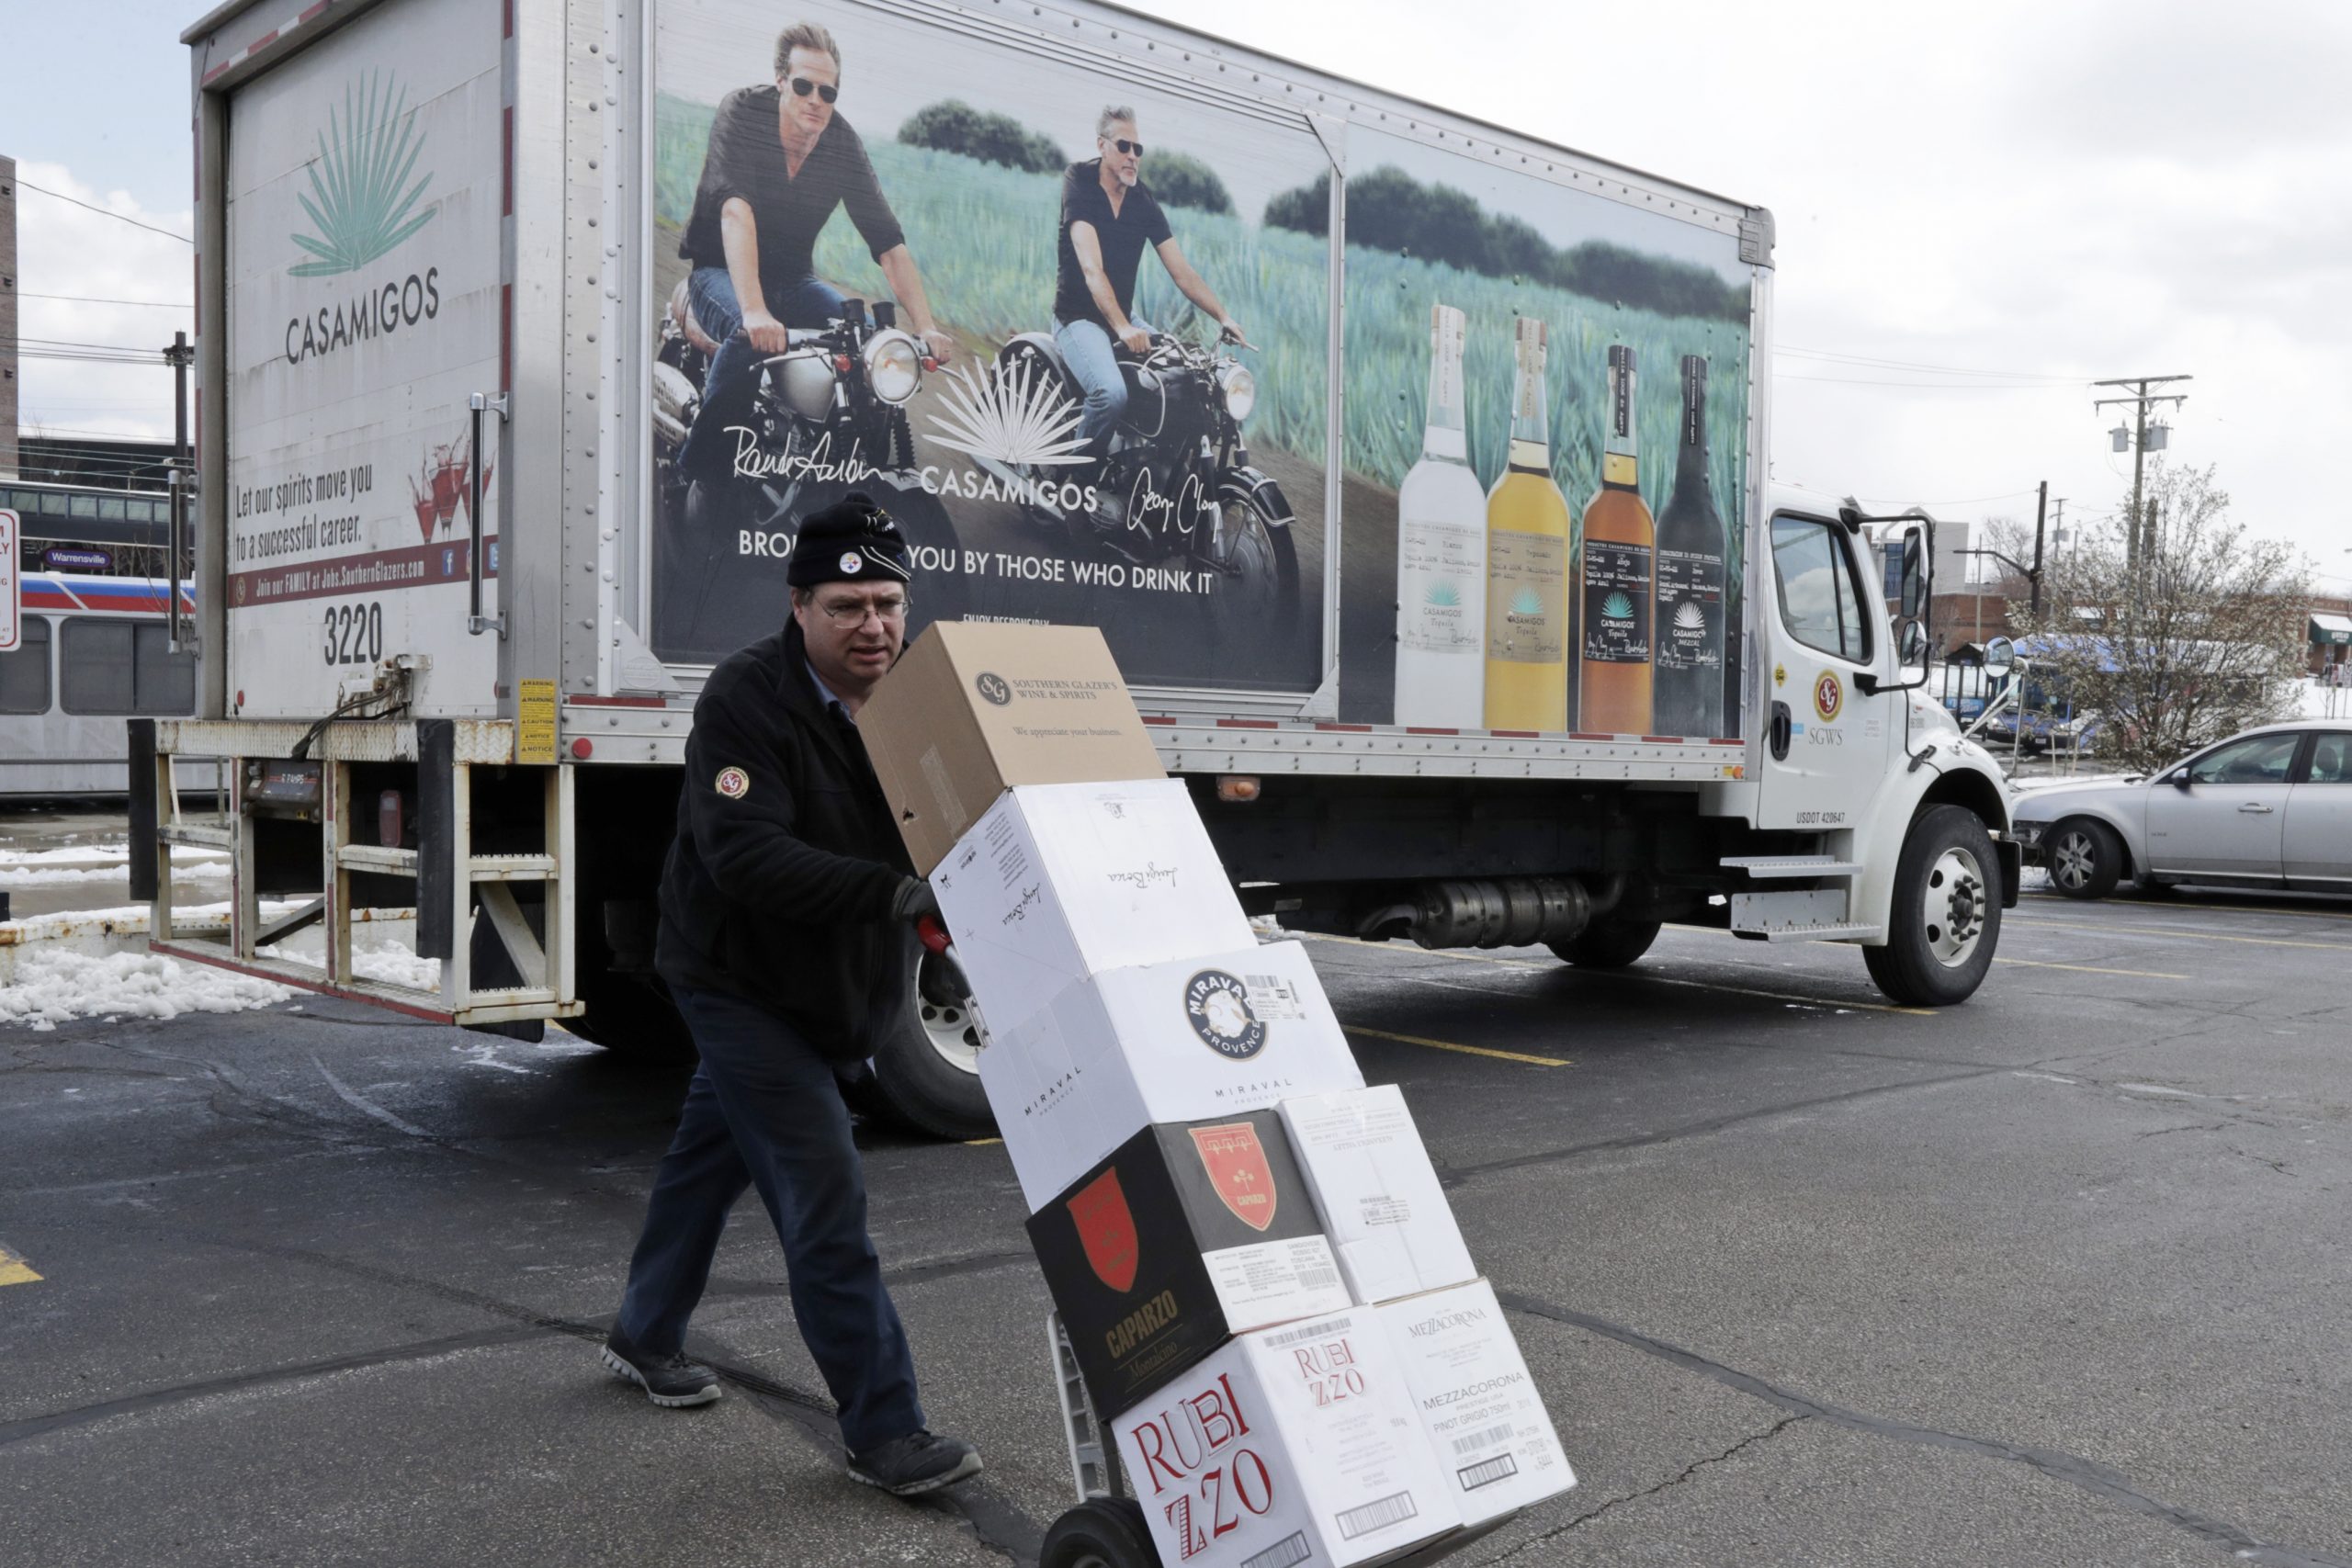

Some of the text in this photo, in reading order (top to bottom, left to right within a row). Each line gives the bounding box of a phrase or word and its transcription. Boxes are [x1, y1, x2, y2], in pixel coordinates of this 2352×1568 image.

[285, 266, 439, 365] CASAMIGOS
[236, 463, 372, 518] Let our spirits move you
[920, 466, 1097, 513] CASAMIGOS
[236, 513, 361, 561] to a successful career.
[51, 553, 106, 564] Warrensville
[906, 544, 956, 574] YOU
[964, 551, 989, 576] BY
[996, 554, 1065, 582] THOSE
[1071, 560, 1125, 588] WHO
[1132, 566, 1193, 592] DRINK
[1197, 572, 1213, 594] IT
[256, 559, 424, 598] Join our FAMILY at Jobs.SouthernGlazers.com
[1423, 608, 1462, 618] CASAMIGOS
[1430, 618, 1454, 628] Tequila
[324, 602, 382, 666] 3220
[1516, 627, 1537, 637] Tequila
[1608, 629, 1628, 639] Tequila
[981, 676, 1006, 703] SG
[1012, 679, 1118, 690] SOUTHERN GLAZER'S
[1017, 690, 1047, 699] WINE
[1060, 691, 1097, 699] SPIRITS
[1013, 727, 1028, 735] We
[1030, 727, 1069, 738] appreciate
[1070, 728, 1088, 738] your
[1809, 728, 1843, 746] SGWS
[1796, 812, 1845, 824] USDOT 420647
[1202, 1019, 1261, 1053] PROVENCE
[1024, 1066, 1081, 1116] MIRAVAL
[1215, 1078, 1292, 1097] MIRAVAL
[1237, 1193, 1267, 1206] CAPARZO
[1105, 1289, 1178, 1359] CAPARZO
[1408, 1308, 1488, 1338] MEZZACORONA
[1130, 1339, 1178, 1380] Montalcino
[1293, 1338, 1356, 1379] RUBI
[1308, 1368, 1365, 1407] ZZO
[1423, 1371, 1525, 1411] MEZZACORONA
[1130, 1372, 1250, 1496] RUBI
[1432, 1402, 1511, 1433] PINOT GRIGIO 750ml
[1164, 1449, 1272, 1561] ZZO
